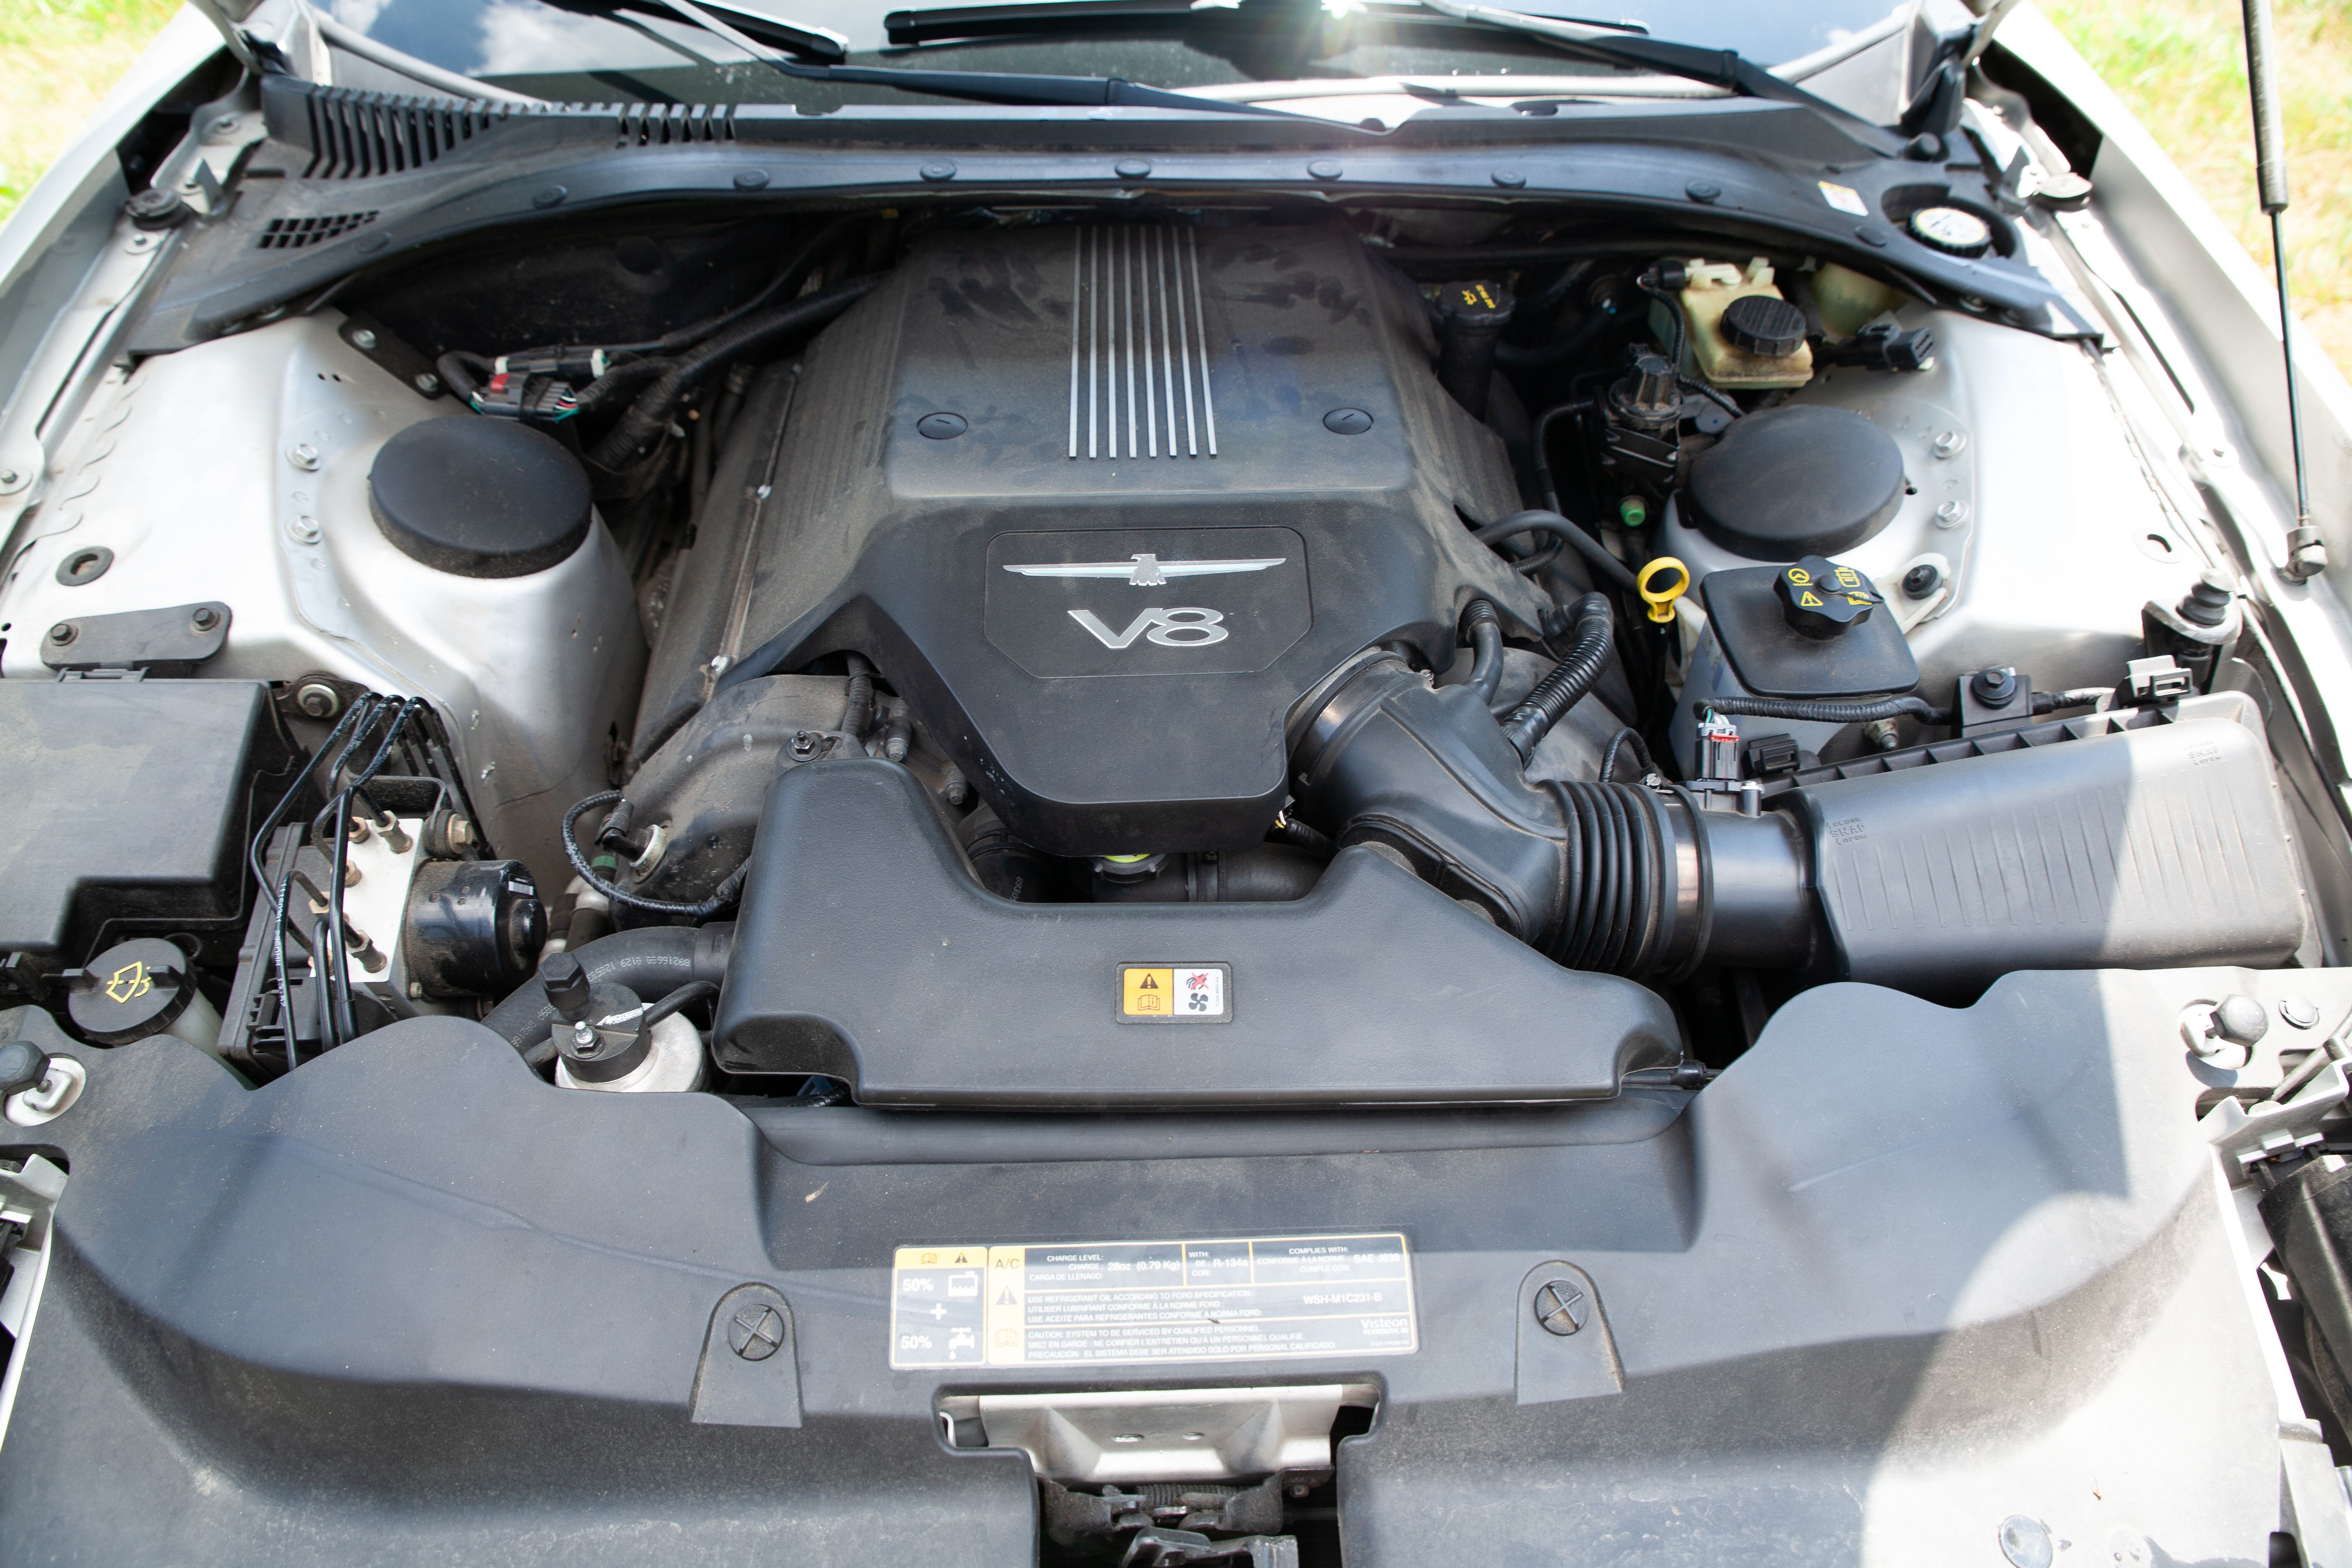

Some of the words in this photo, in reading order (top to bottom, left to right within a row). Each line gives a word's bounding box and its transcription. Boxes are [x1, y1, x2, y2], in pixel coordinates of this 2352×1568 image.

[1067, 607, 1229, 649] V8
[1833, 818, 1862, 826] CLOSE
[1829, 823, 1866, 837] SNAP
[1842, 834, 1867, 843] OPEN
[995, 1258, 1020, 1270] A/C
[1213, 1259, 1248, 1268] R-134a
[1354, 1254, 1374, 1264] SAE
[1377, 1253, 1400, 1263] J639
[1107, 1262, 1131, 1271] 28oz
[1137, 1261, 1161, 1272] (0.79
[1163, 1261, 1180, 1271] Kg)
[903, 1278, 934, 1292] 50%
[1045, 1294, 1098, 1302] REFRIGERANT
[1113, 1292, 1158, 1301] ACCORDING
[1303, 1292, 1382, 1305] WSH-M1C231-B
[1108, 1302, 1151, 1311] CONFORME
[1095, 1312, 1158, 1320] REFRIGERANTES
[1159, 1311, 1202, 1320] CONFORME
[1360, 1318, 1408, 1329] Visteon
[1028, 1330, 1065, 1338] CAUTION:
[1122, 1328, 1160, 1336] SERVICED
[1173, 1326, 1213, 1335] QUALIFIED
[900, 1335, 933, 1349] 50%
[1105, 1338, 1140, 1346] CONFIER
[1248, 1343, 1289, 1351] PERSONAL
